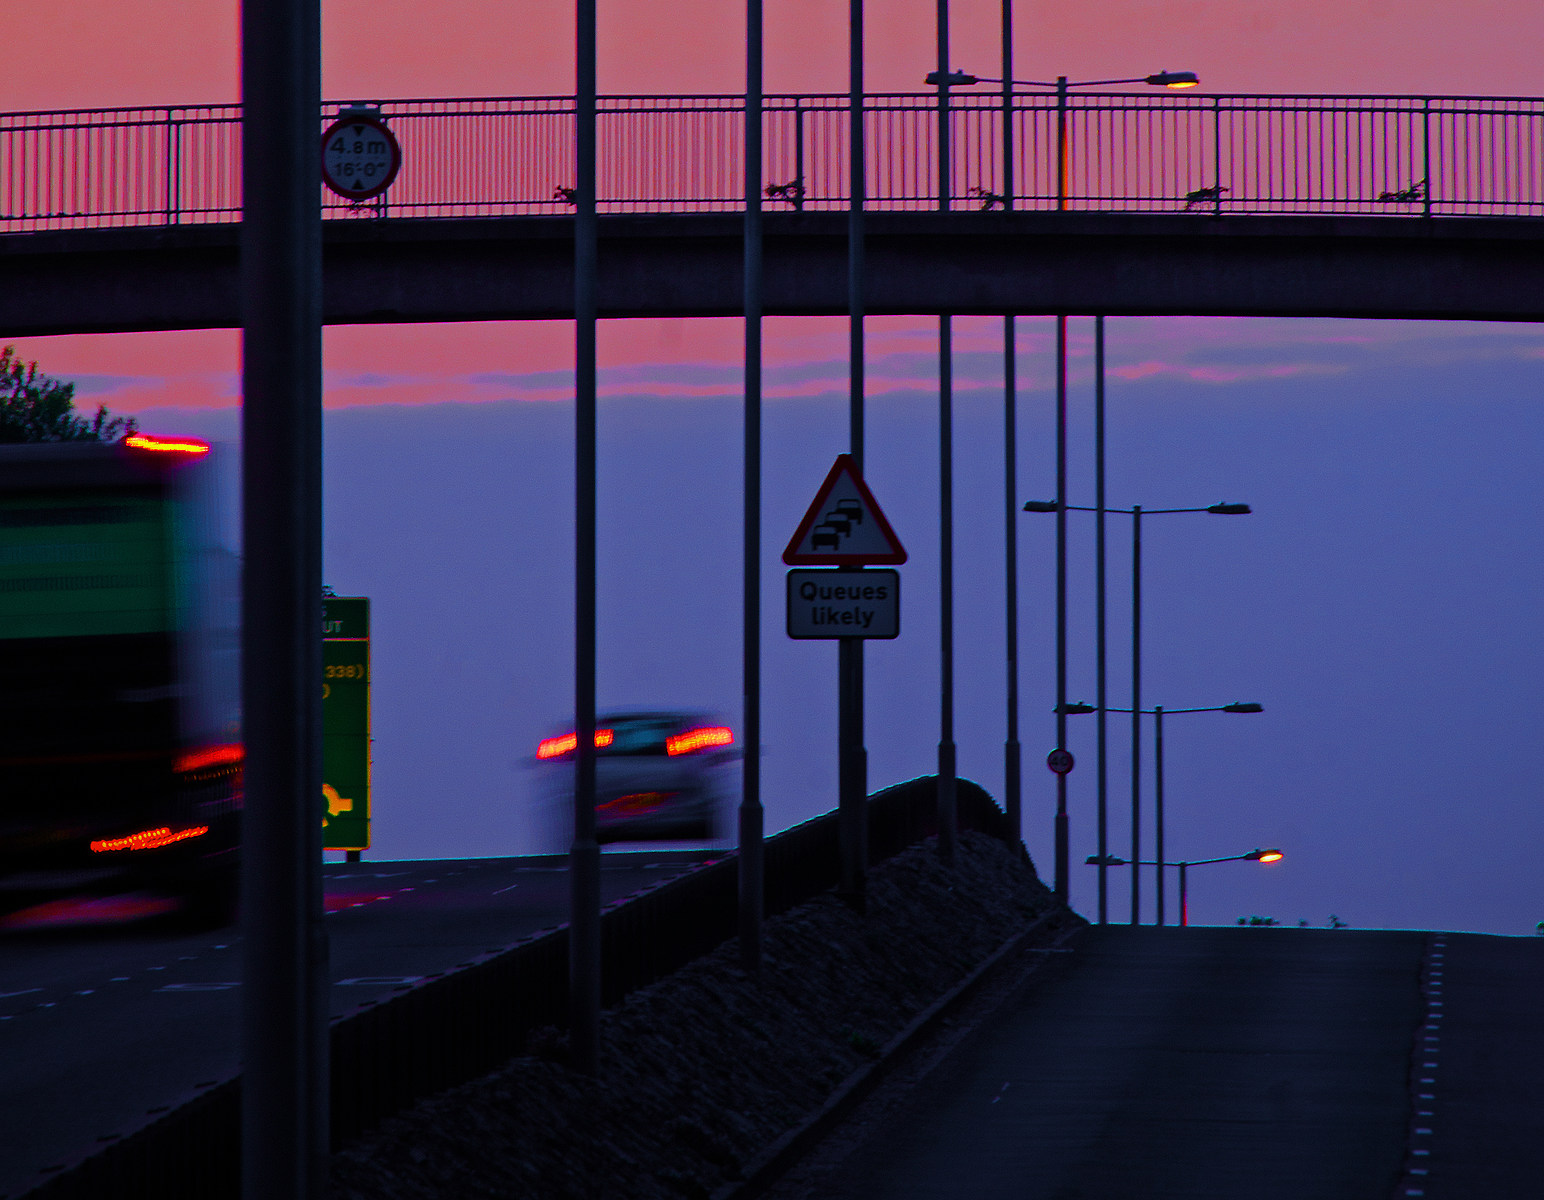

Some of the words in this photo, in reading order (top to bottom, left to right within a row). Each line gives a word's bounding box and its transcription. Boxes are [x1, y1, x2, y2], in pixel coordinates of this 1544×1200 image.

[800, 581, 888, 602] Queues
[322, 620, 344, 633] UT
[812, 606, 875, 629] likely
[324, 663, 366, 681] 338)
